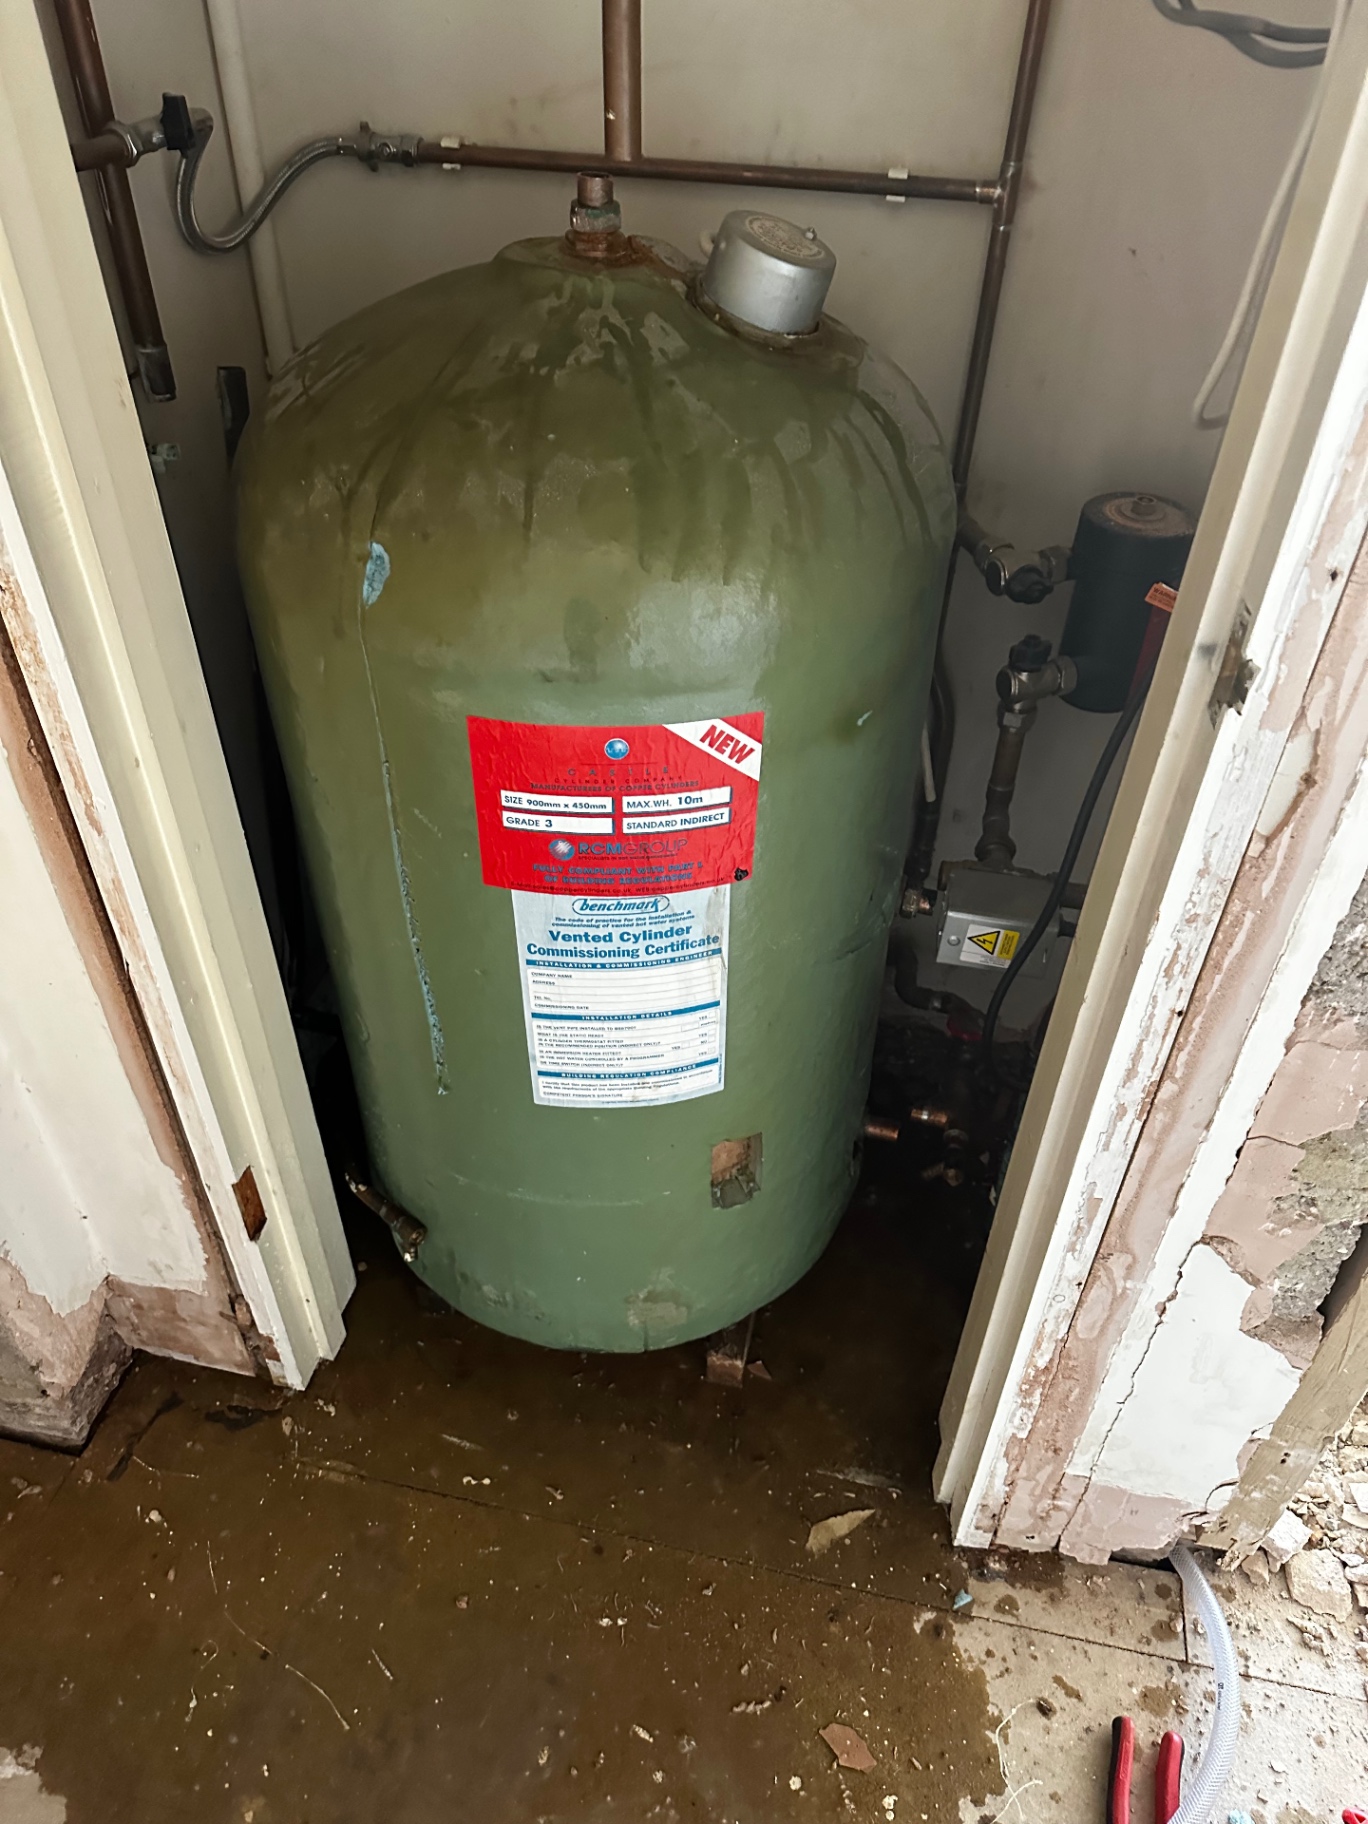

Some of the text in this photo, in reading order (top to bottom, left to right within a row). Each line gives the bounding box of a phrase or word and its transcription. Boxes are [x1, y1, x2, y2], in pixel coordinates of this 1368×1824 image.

[699, 724, 756, 764] NEW
[530, 782, 602, 791] MANUFACTURERS
[619, 784, 652, 792] COPPER
[655, 781, 699, 790] CYLINDERS
[504, 795, 523, 805] SIZE
[526, 799, 561, 808] 900mm
[572, 802, 607, 810] 450mm
[677, 795, 703, 805] 10m
[506, 816, 553, 828] GRADE 3
[626, 812, 725, 830] STANDARD INDIRECT
[578, 838, 688, 855] RCMGROUP
[532, 863, 564, 873] FULLY
[568, 867, 631, 875] COMPLIANT
[636, 866, 665, 875] WITH
[668, 862, 694, 871] PART
[544, 872, 692, 885] OF BUILDING REGULATIONS
[579, 898, 662, 912] benchmark
[551, 921, 600, 929] commissioning
[669, 914, 695, 923] systems
[648, 911, 685, 920] installation
[548, 925, 693, 944] Vented Cylinder
[526, 934, 720, 959] Commissioning Certificate
[536, 961, 592, 969] INSTALLATION
[605, 958, 672, 968] COMMISSIONING
[674, 951, 713, 962] ENGINEER
[650, 1063, 697, 1076] COMPLIANCE
